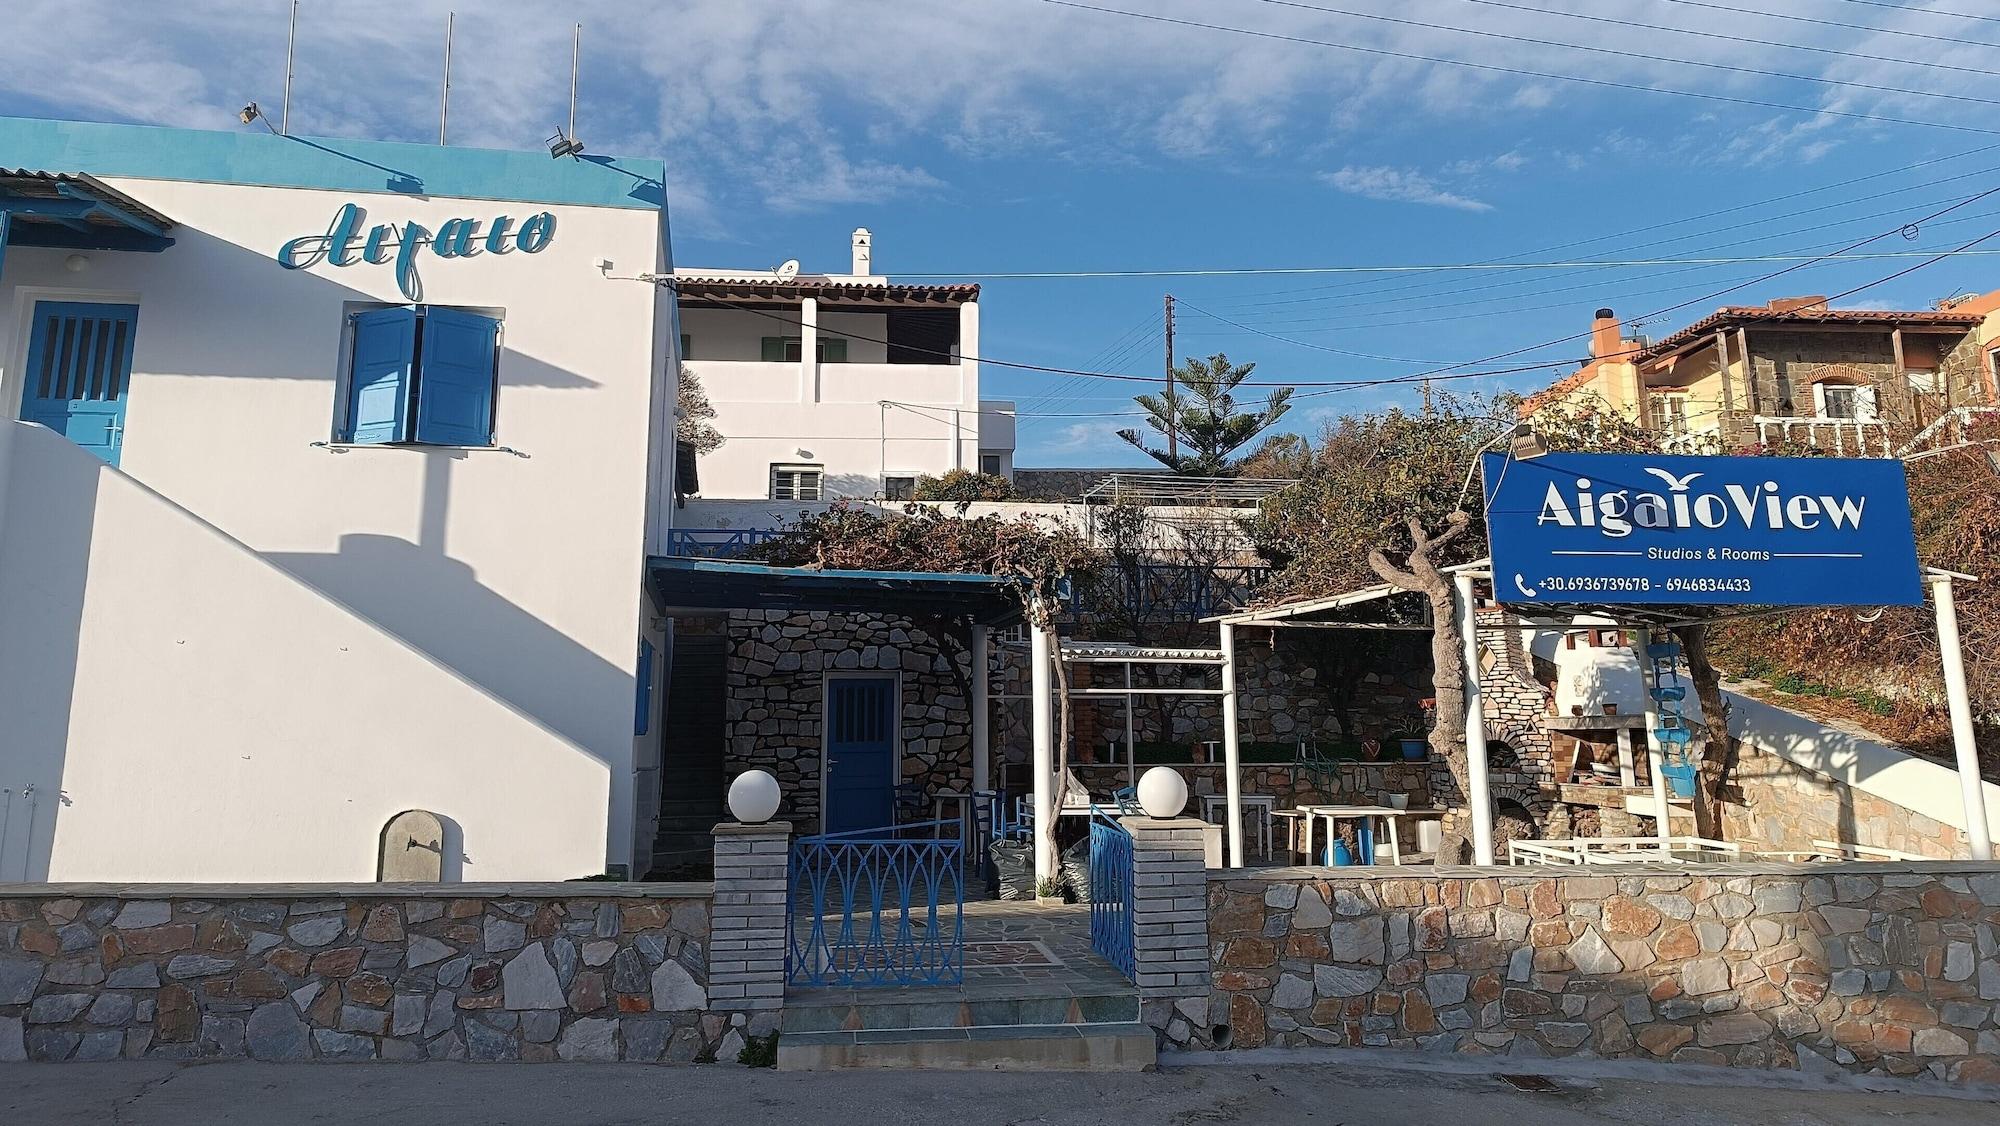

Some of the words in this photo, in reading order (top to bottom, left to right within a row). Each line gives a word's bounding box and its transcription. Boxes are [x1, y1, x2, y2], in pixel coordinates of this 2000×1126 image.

[1647, 547, 1702, 560] Studios
[1706, 547, 1717, 560] &
[1721, 547, 1770, 561] Rooms
[1538, 576, 1650, 591] +30.6936739678
[1666, 578, 1751, 592] 6946834433
